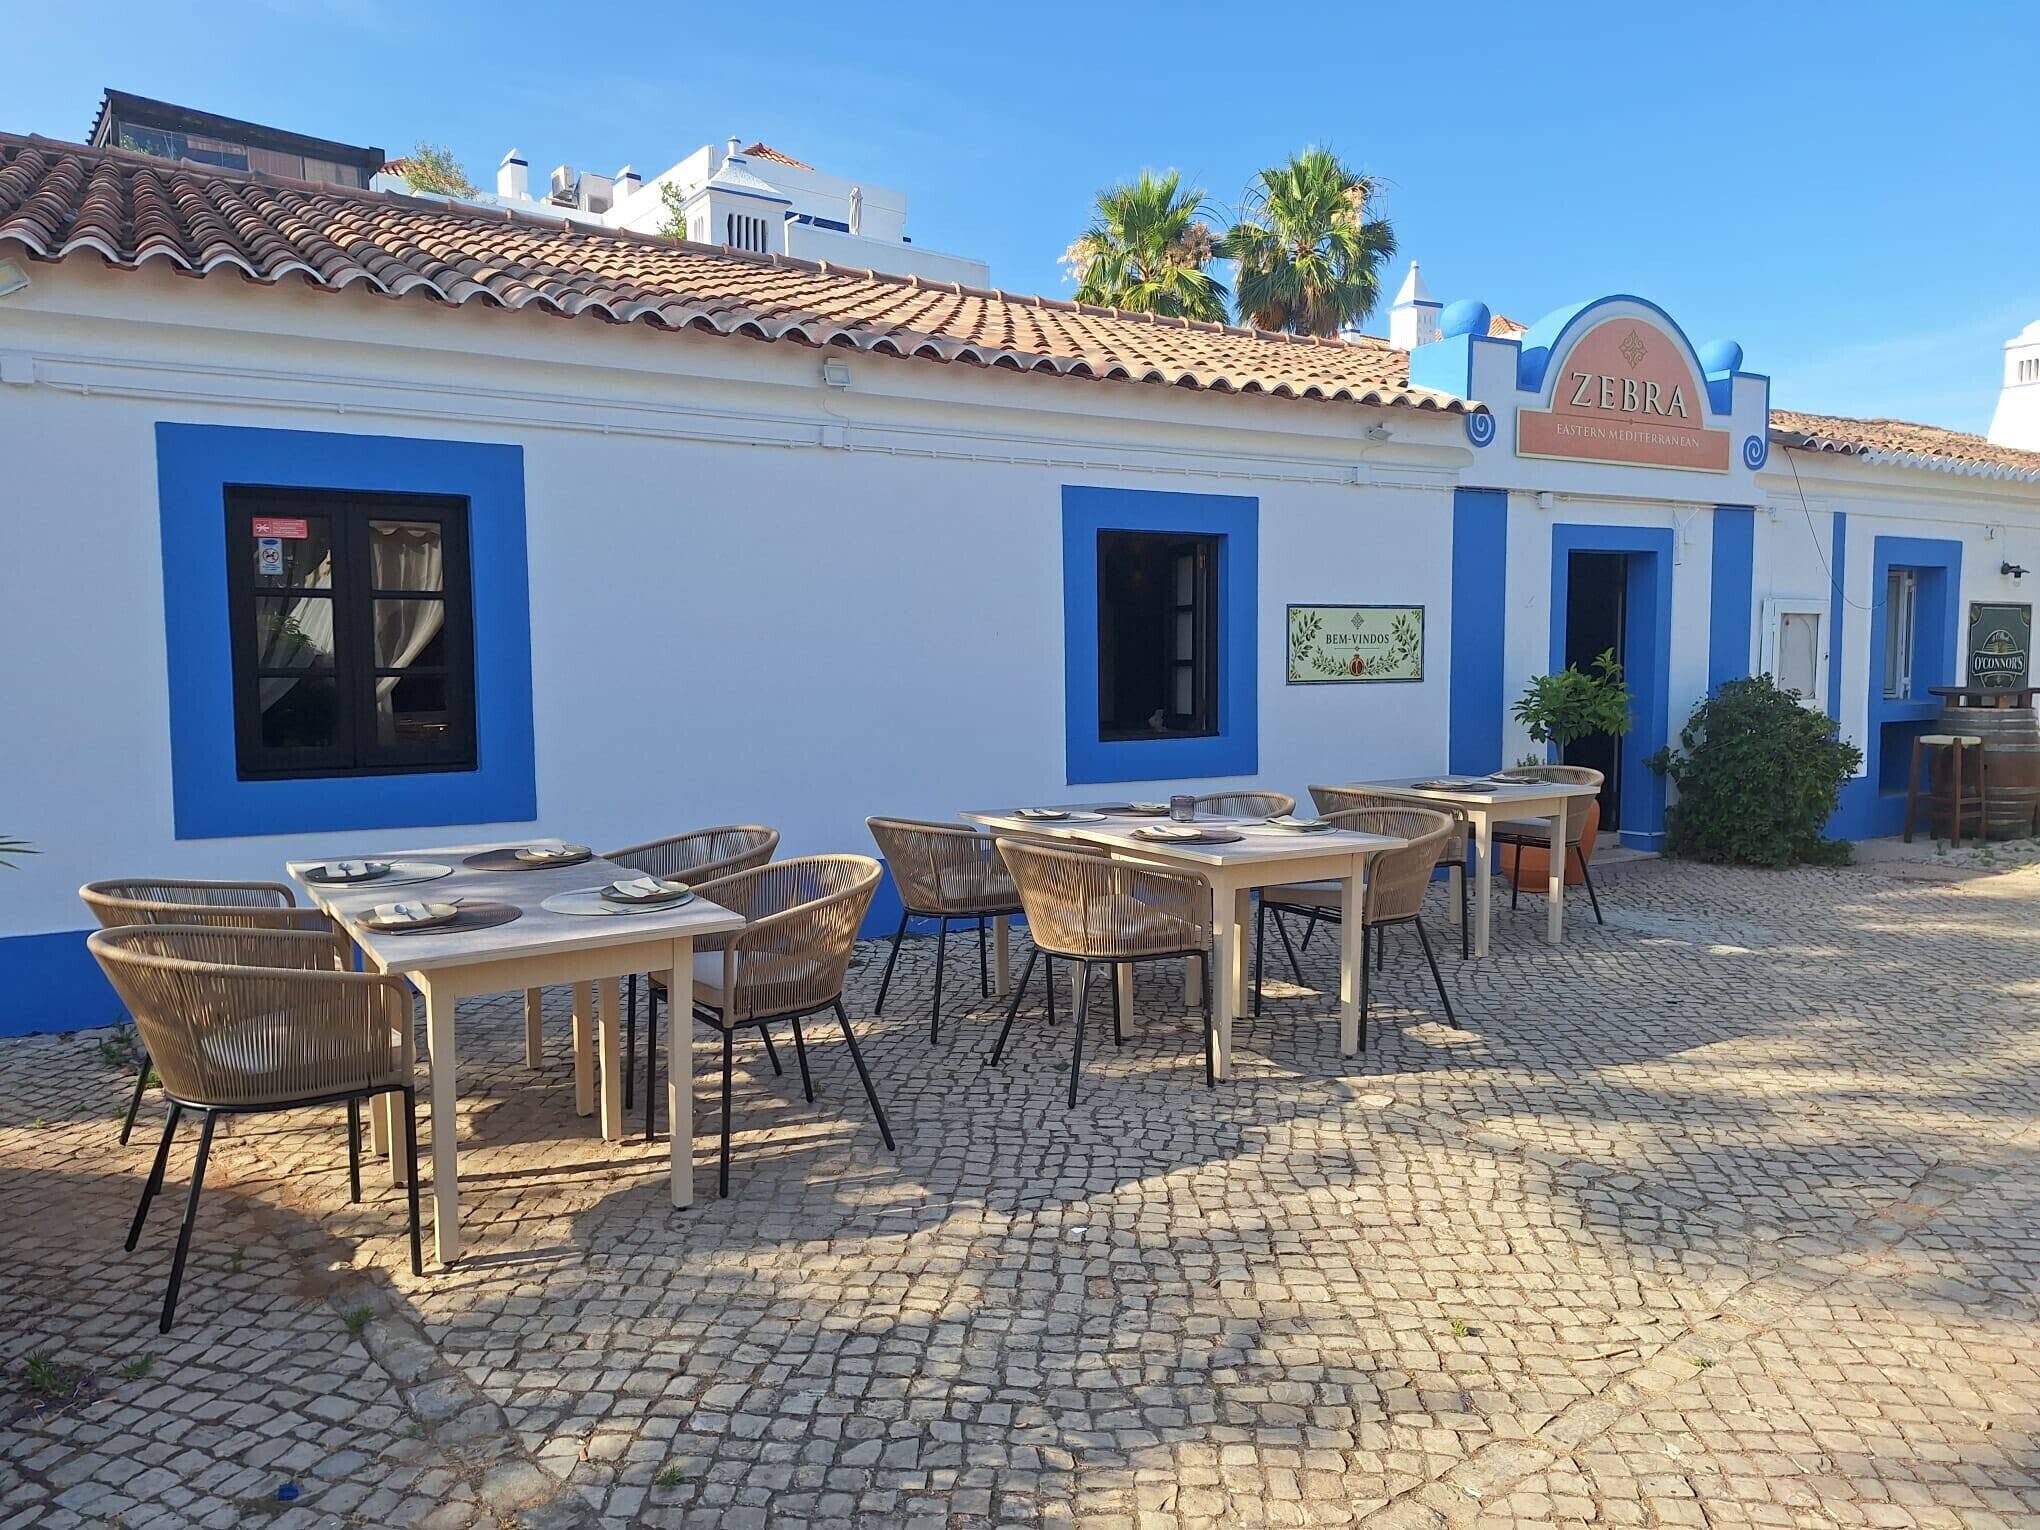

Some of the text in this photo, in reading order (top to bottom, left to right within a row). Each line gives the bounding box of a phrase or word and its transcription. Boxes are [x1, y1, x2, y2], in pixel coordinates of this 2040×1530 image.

[1571, 372, 1689, 418] ZEBRA
[1557, 423, 1699, 447] EASTERN MEDITERRANEAN
[1326, 633, 1390, 645] BEM-VINDOS
